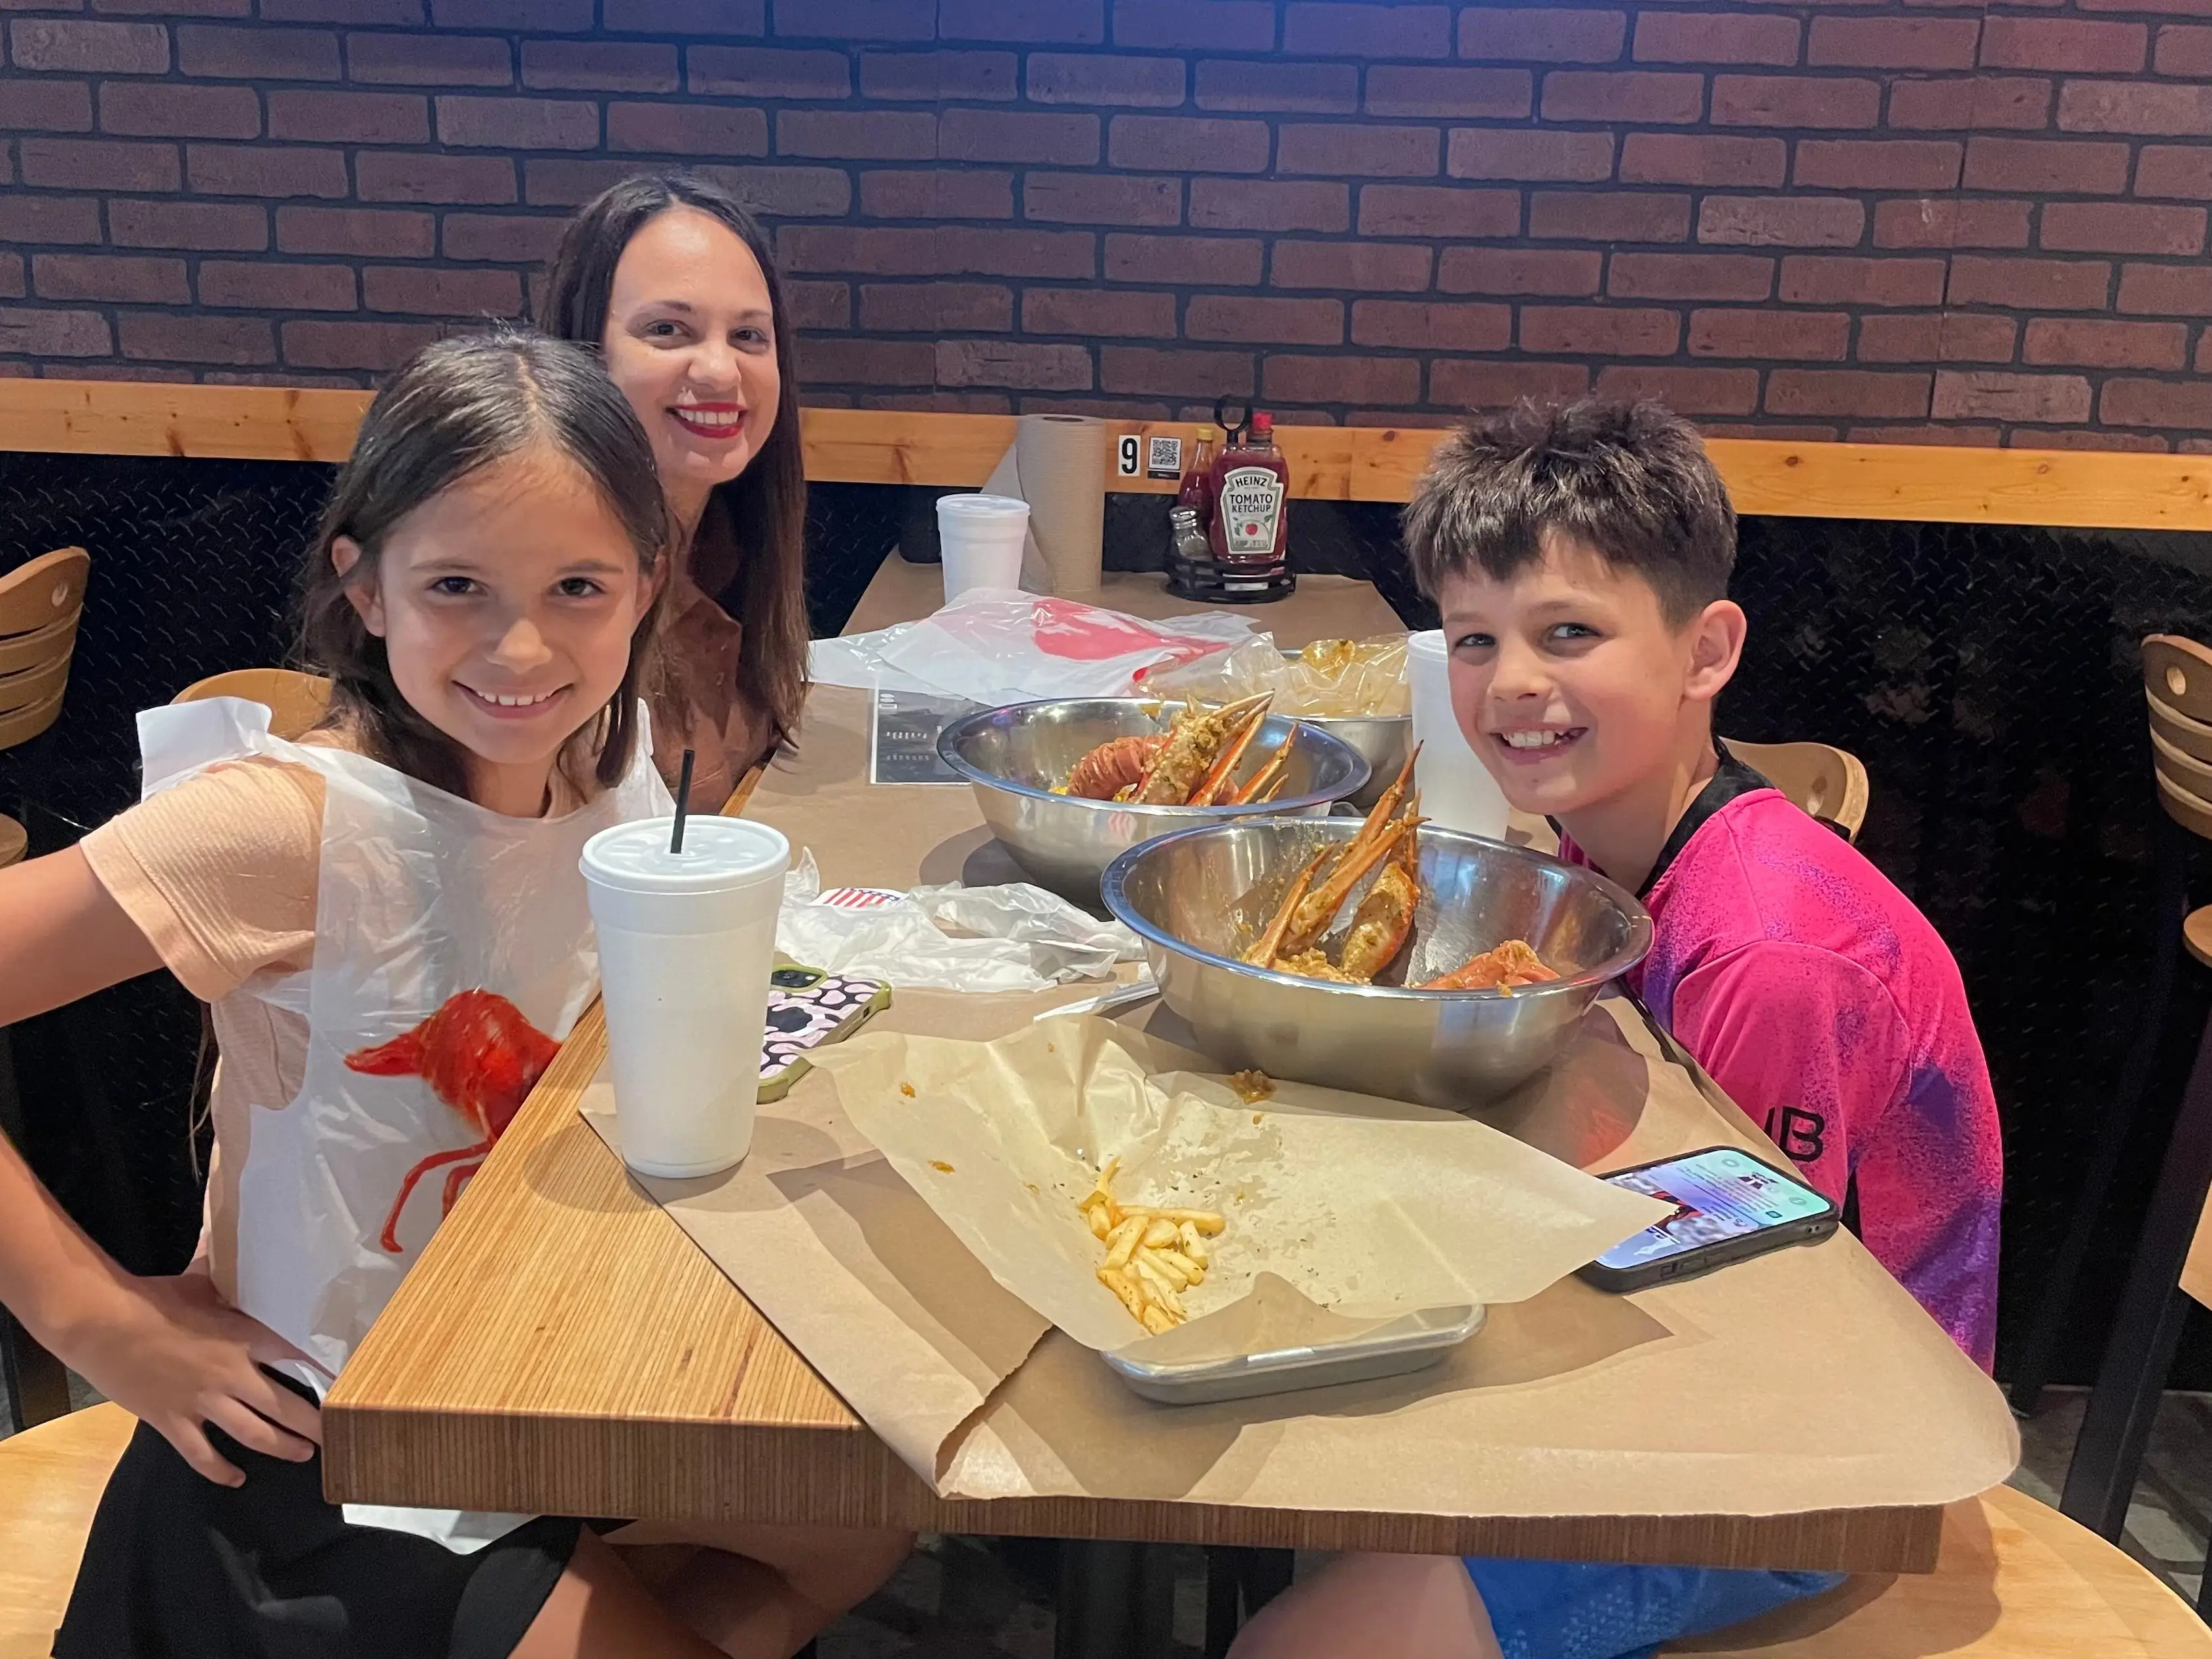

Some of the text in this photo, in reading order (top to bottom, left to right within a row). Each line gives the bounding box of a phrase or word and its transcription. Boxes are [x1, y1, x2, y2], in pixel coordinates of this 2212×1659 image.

[1122, 438, 1137, 474] 9
[1235, 476, 1267, 487] HEINZ
[1230, 493, 1273, 505] TOMATO
[1232, 504, 1271, 513] KETCHUP
